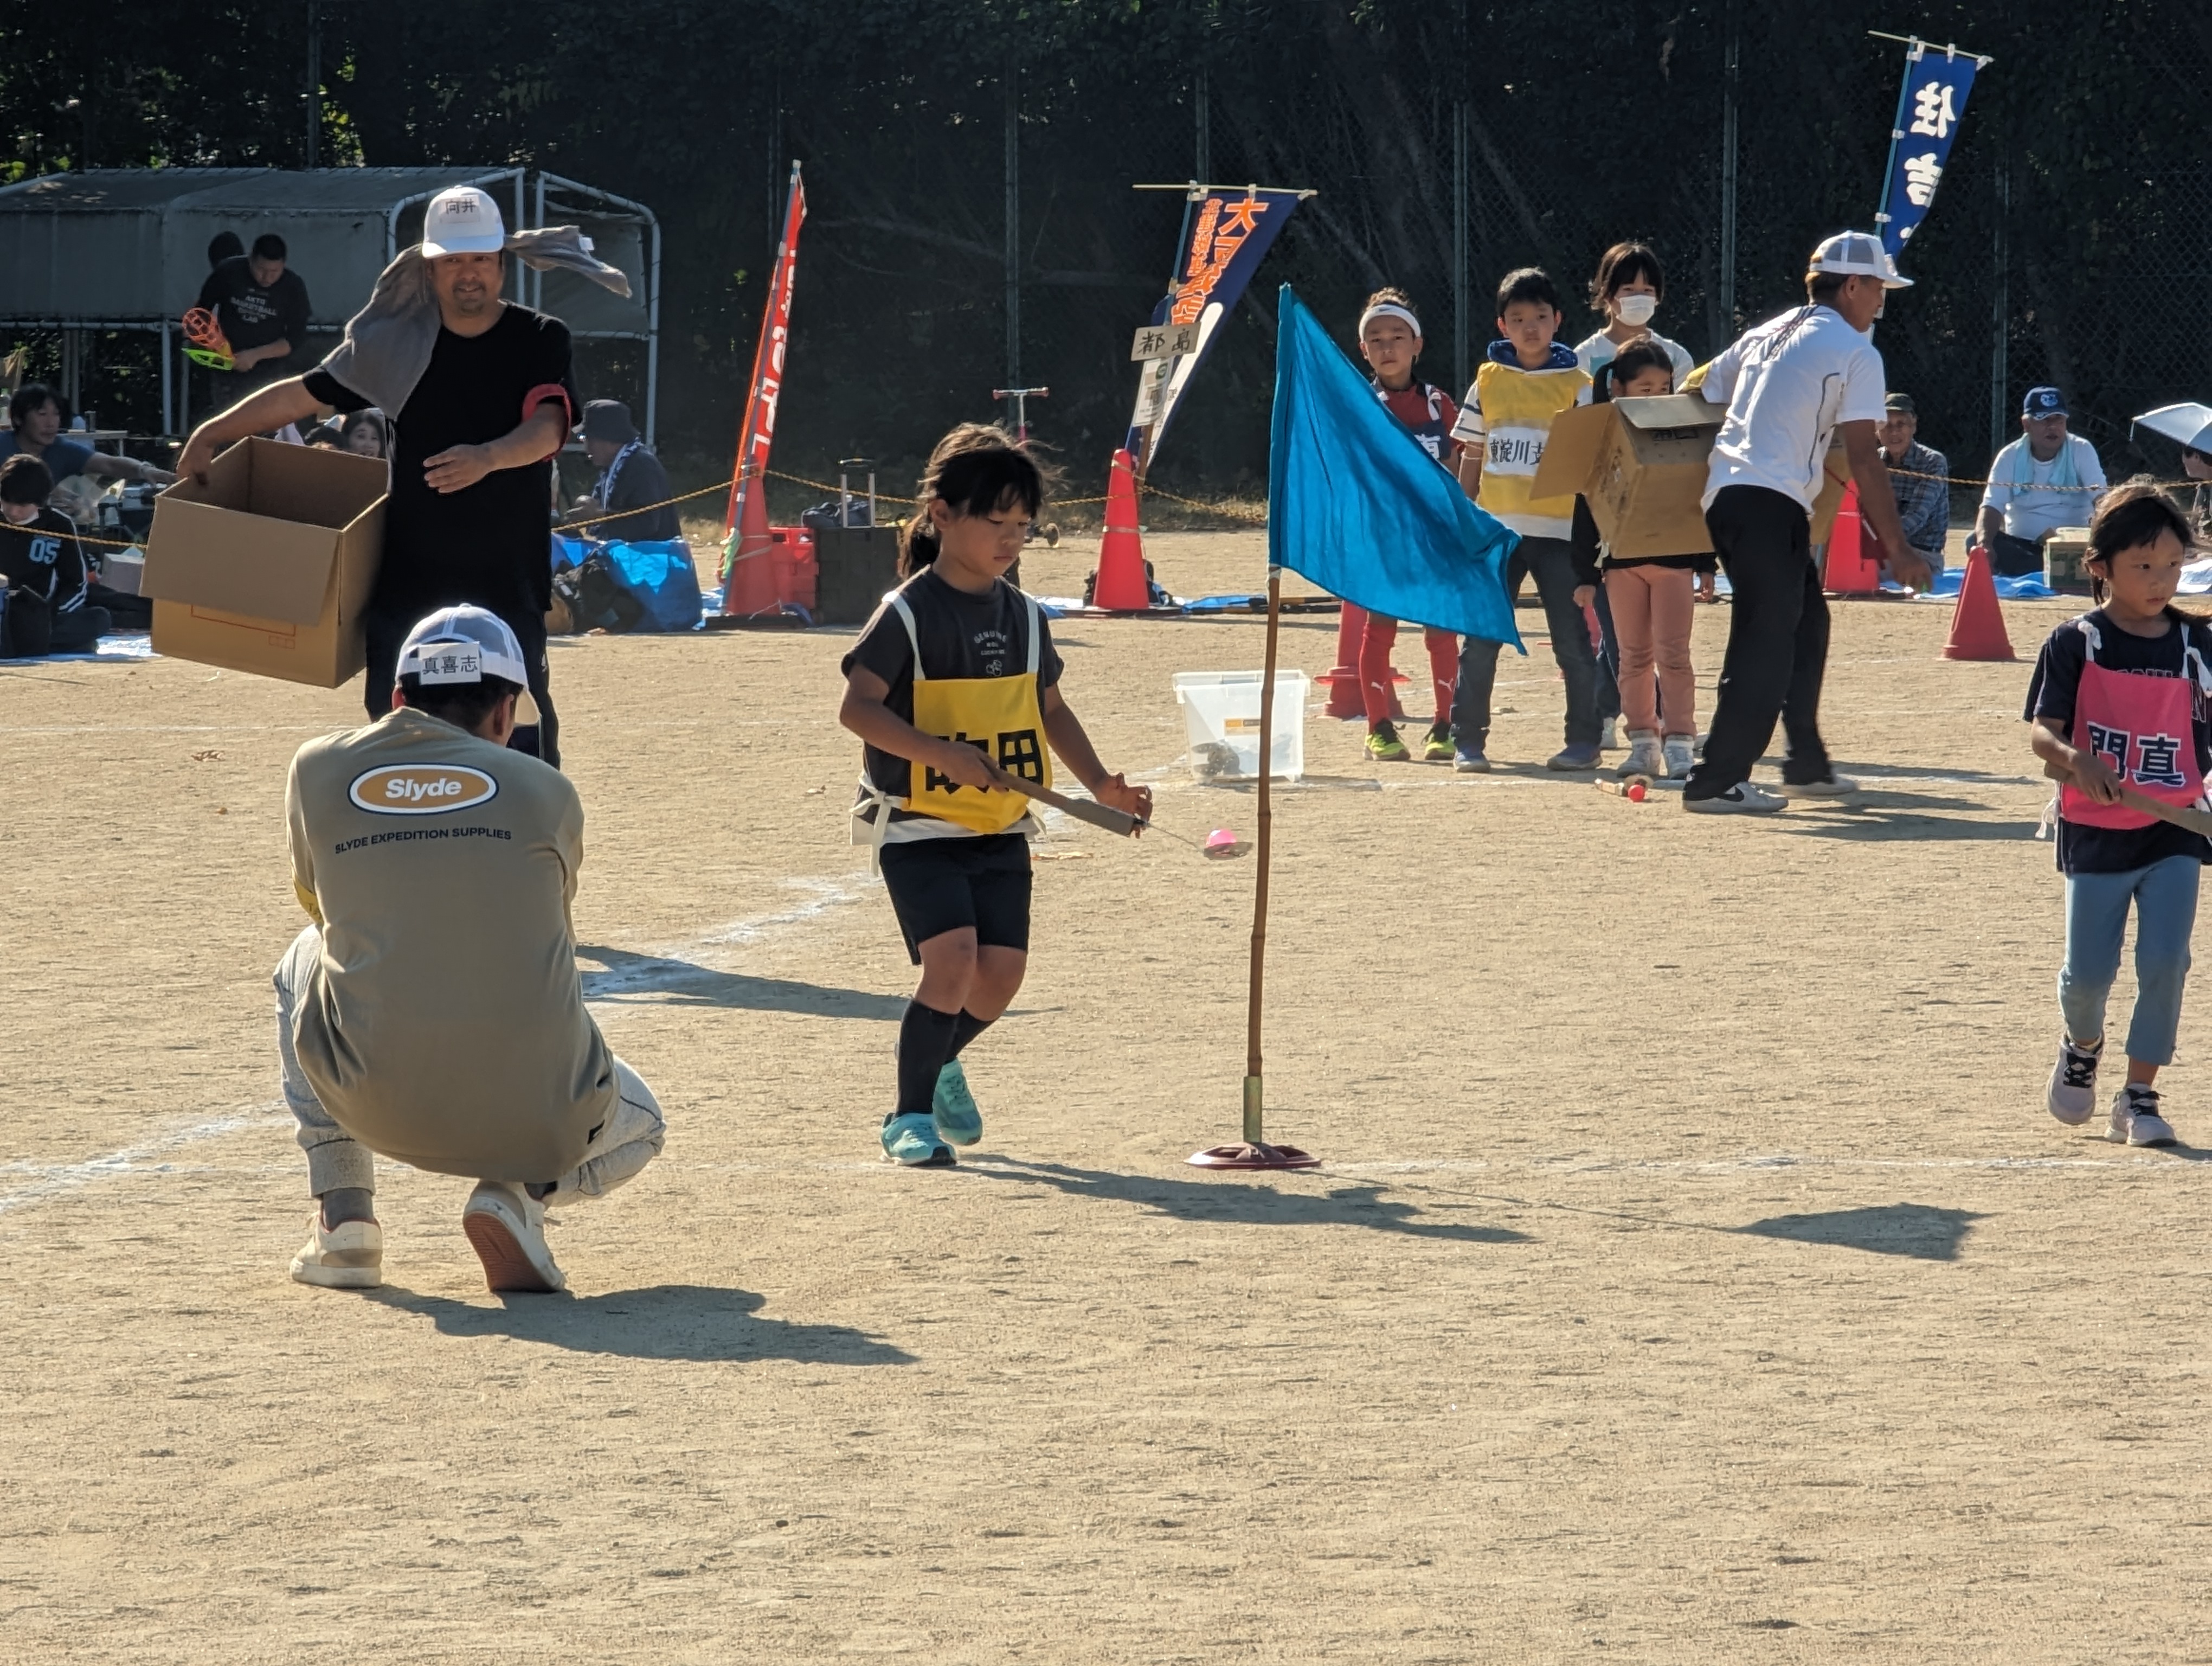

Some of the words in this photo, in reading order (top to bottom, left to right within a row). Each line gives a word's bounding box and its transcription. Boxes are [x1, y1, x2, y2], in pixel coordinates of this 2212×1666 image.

[446, 198, 477, 214] 向井
[1137, 328, 1190, 355] 都島
[29, 538, 61, 565] 05
[422, 655, 478, 675] 真喜志
[2087, 721, 2187, 789] 門真
[385, 778, 462, 802] Slyde
[335, 836, 368, 855] SLYDE
[371, 828, 449, 845] EXPEDITION
[452, 826, 512, 841] SUPPLIES
